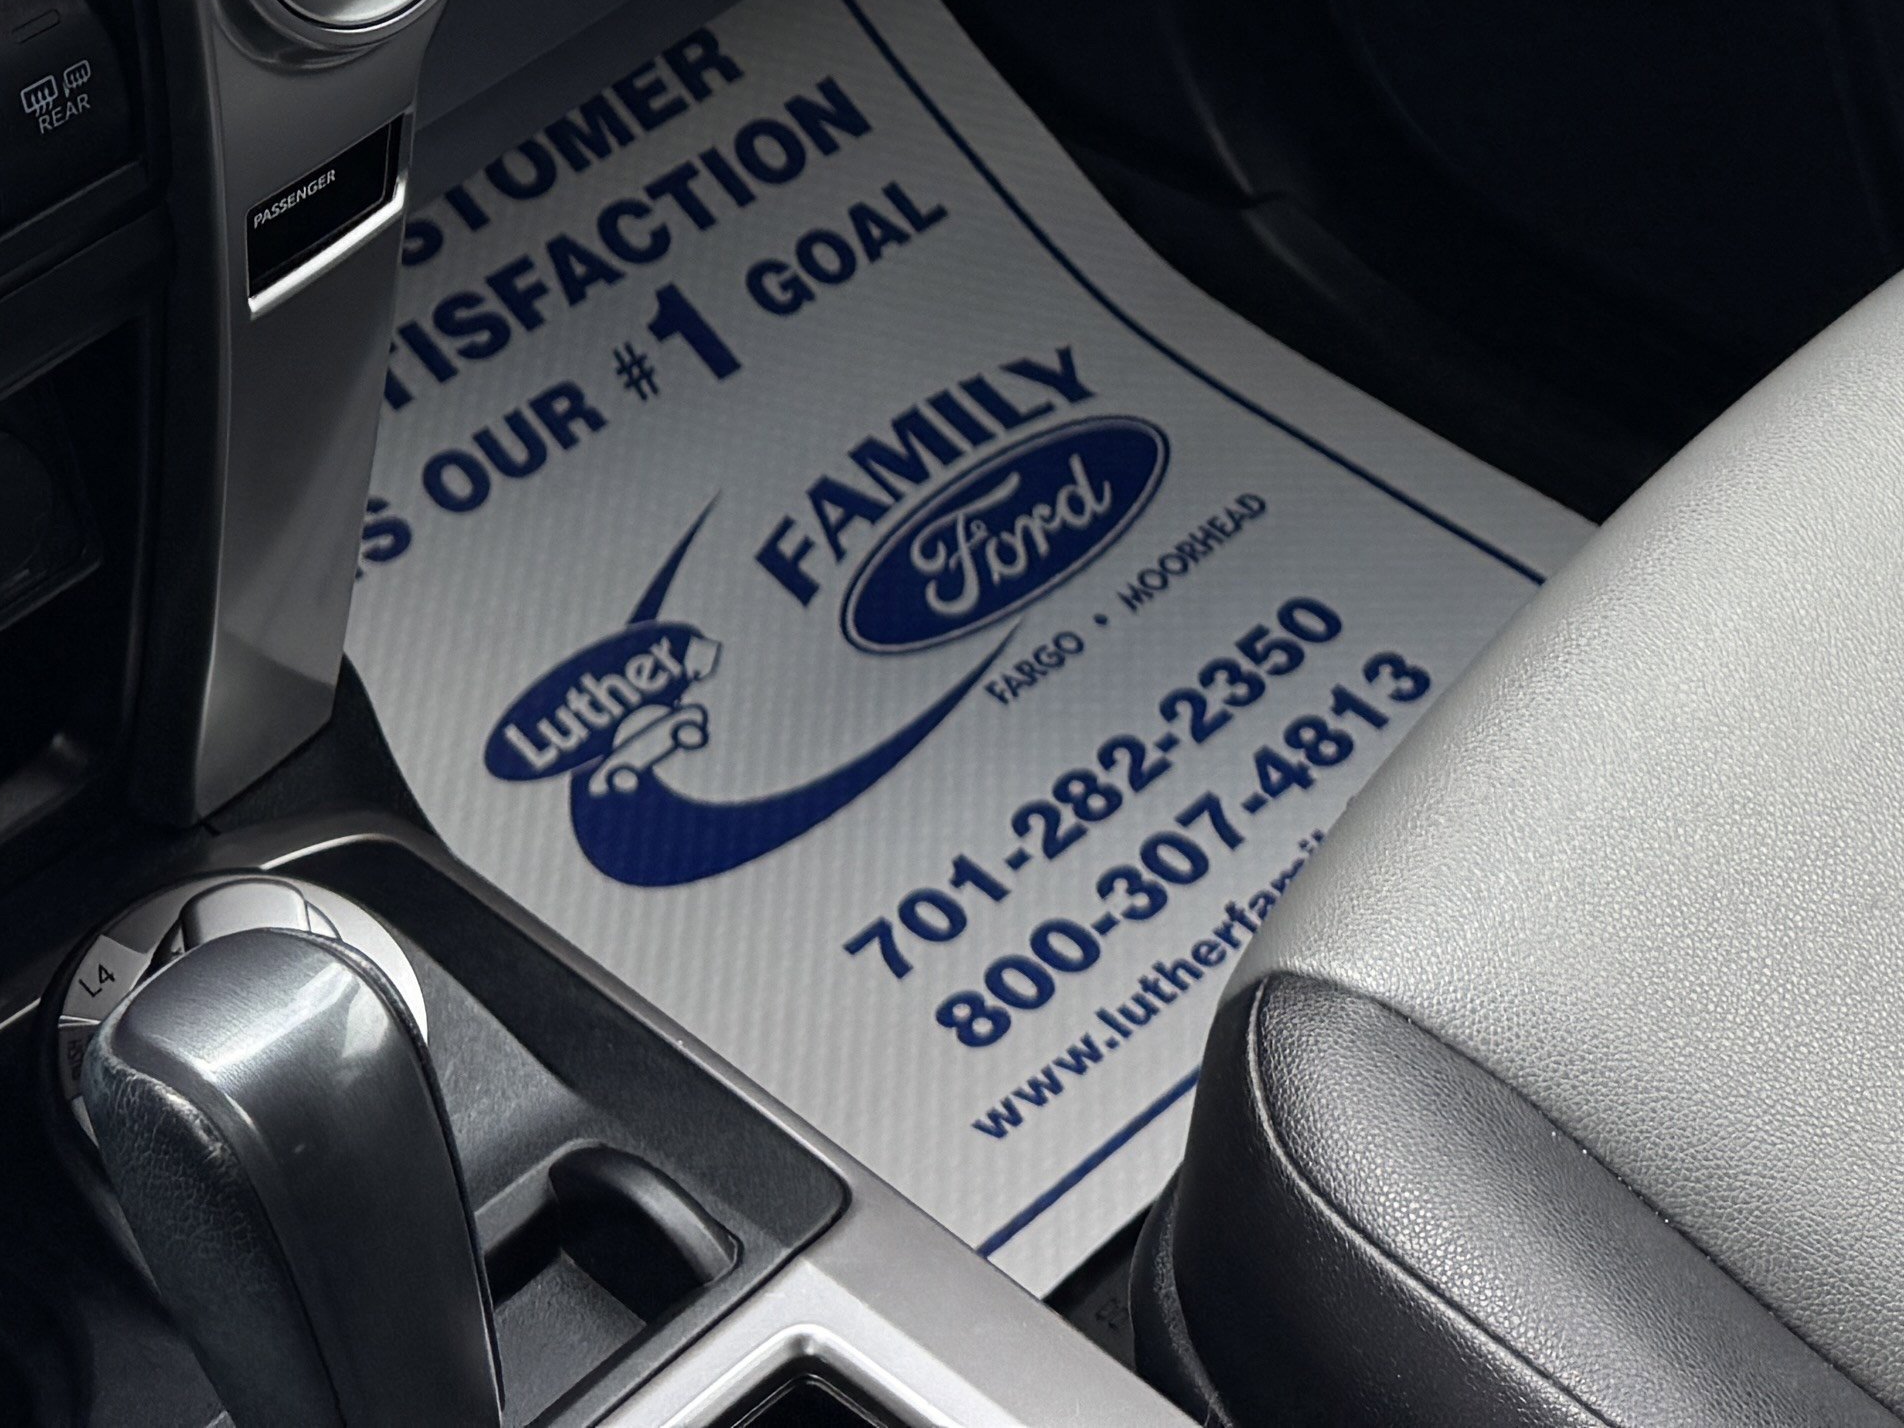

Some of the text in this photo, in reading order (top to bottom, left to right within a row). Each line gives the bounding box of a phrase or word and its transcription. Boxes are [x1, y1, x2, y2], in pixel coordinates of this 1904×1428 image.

[38, 93, 91, 135] REAR
[253, 168, 336, 230] PASSENGER
[421, 379, 610, 515] OUR
[745, 180, 950, 318] GOAL
[753, 346, 1097, 609] FAMILY
[908, 452, 1114, 618] Ford
[983, 491, 1268, 707] FARGO MOORHEAD
[502, 634, 688, 771] Luther
[841, 596, 1343, 981] 701-282-2350
[934, 649, 1432, 1049] 800-307-4813
[79, 963, 116, 998] L4
